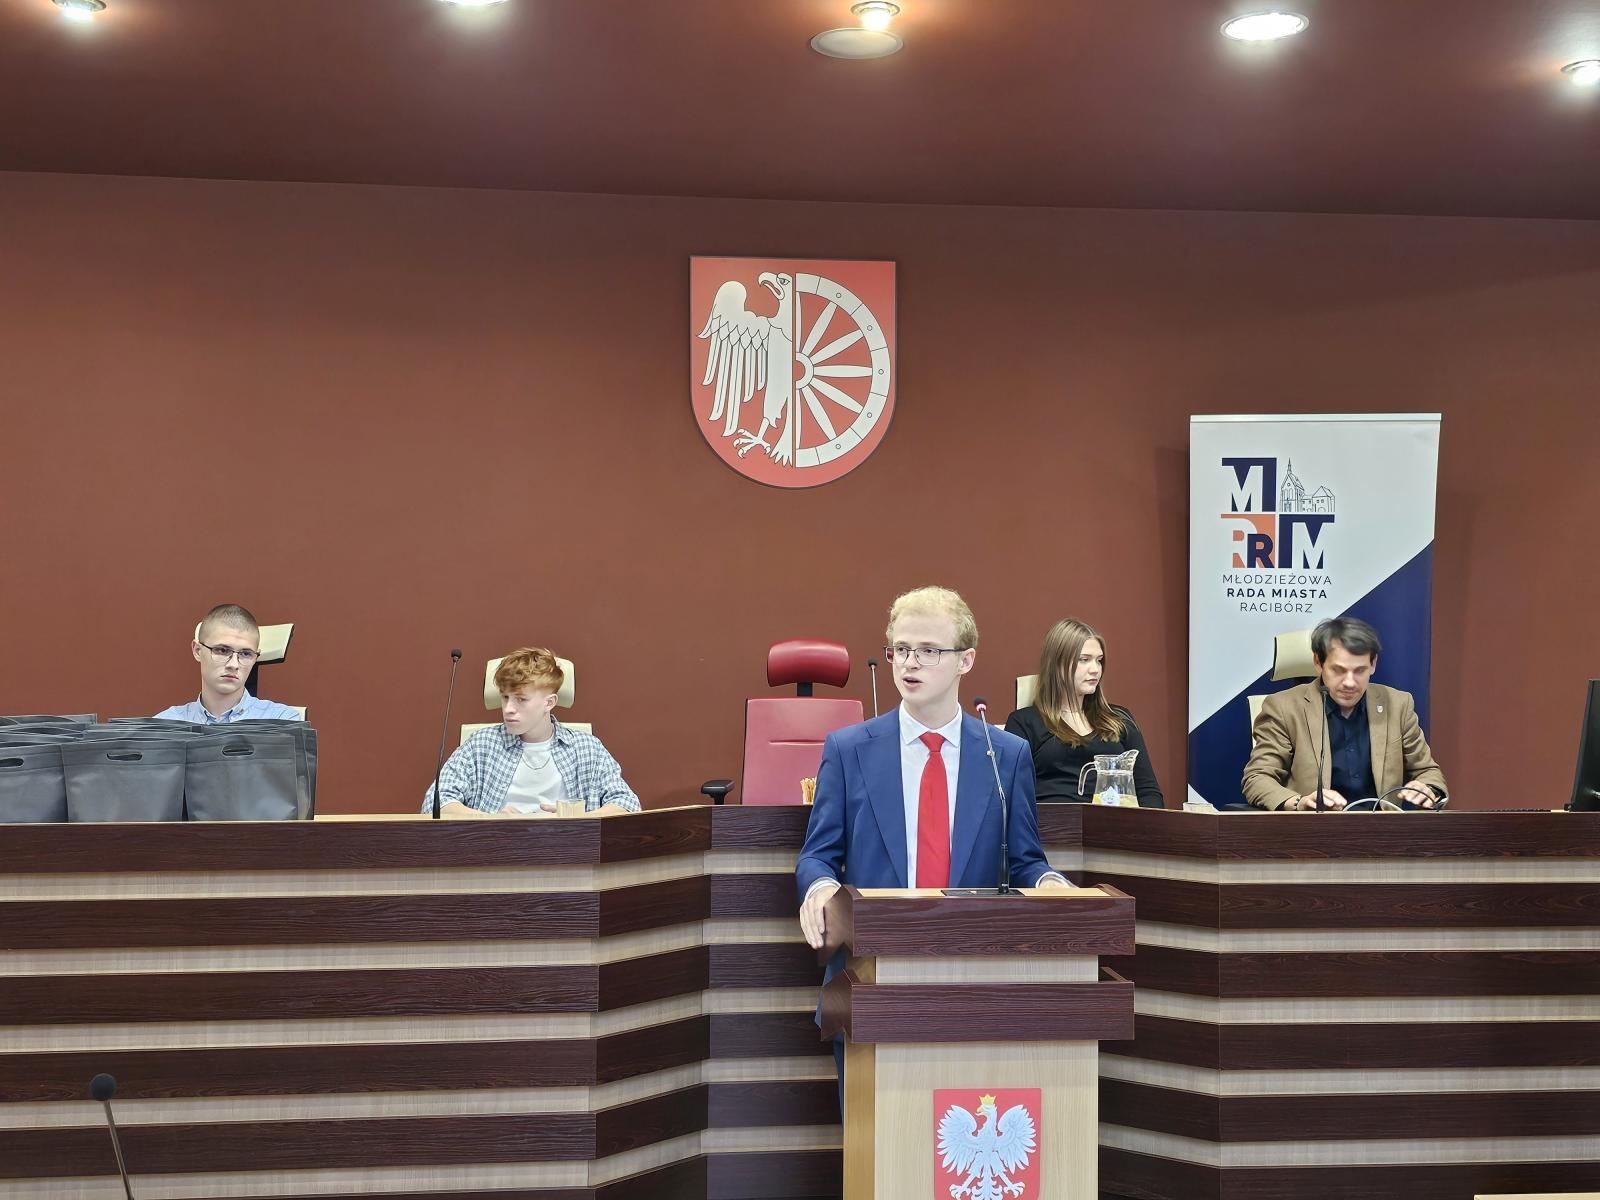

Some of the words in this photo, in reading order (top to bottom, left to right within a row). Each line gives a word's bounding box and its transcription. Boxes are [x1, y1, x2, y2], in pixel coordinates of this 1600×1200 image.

[1222, 573, 1332, 585] MŁODZIEŻOWA
[1227, 588, 1265, 598] RADA
[1272, 589, 1327, 599] MIASTA
[1240, 601, 1312, 613] RACIBÓRZ
